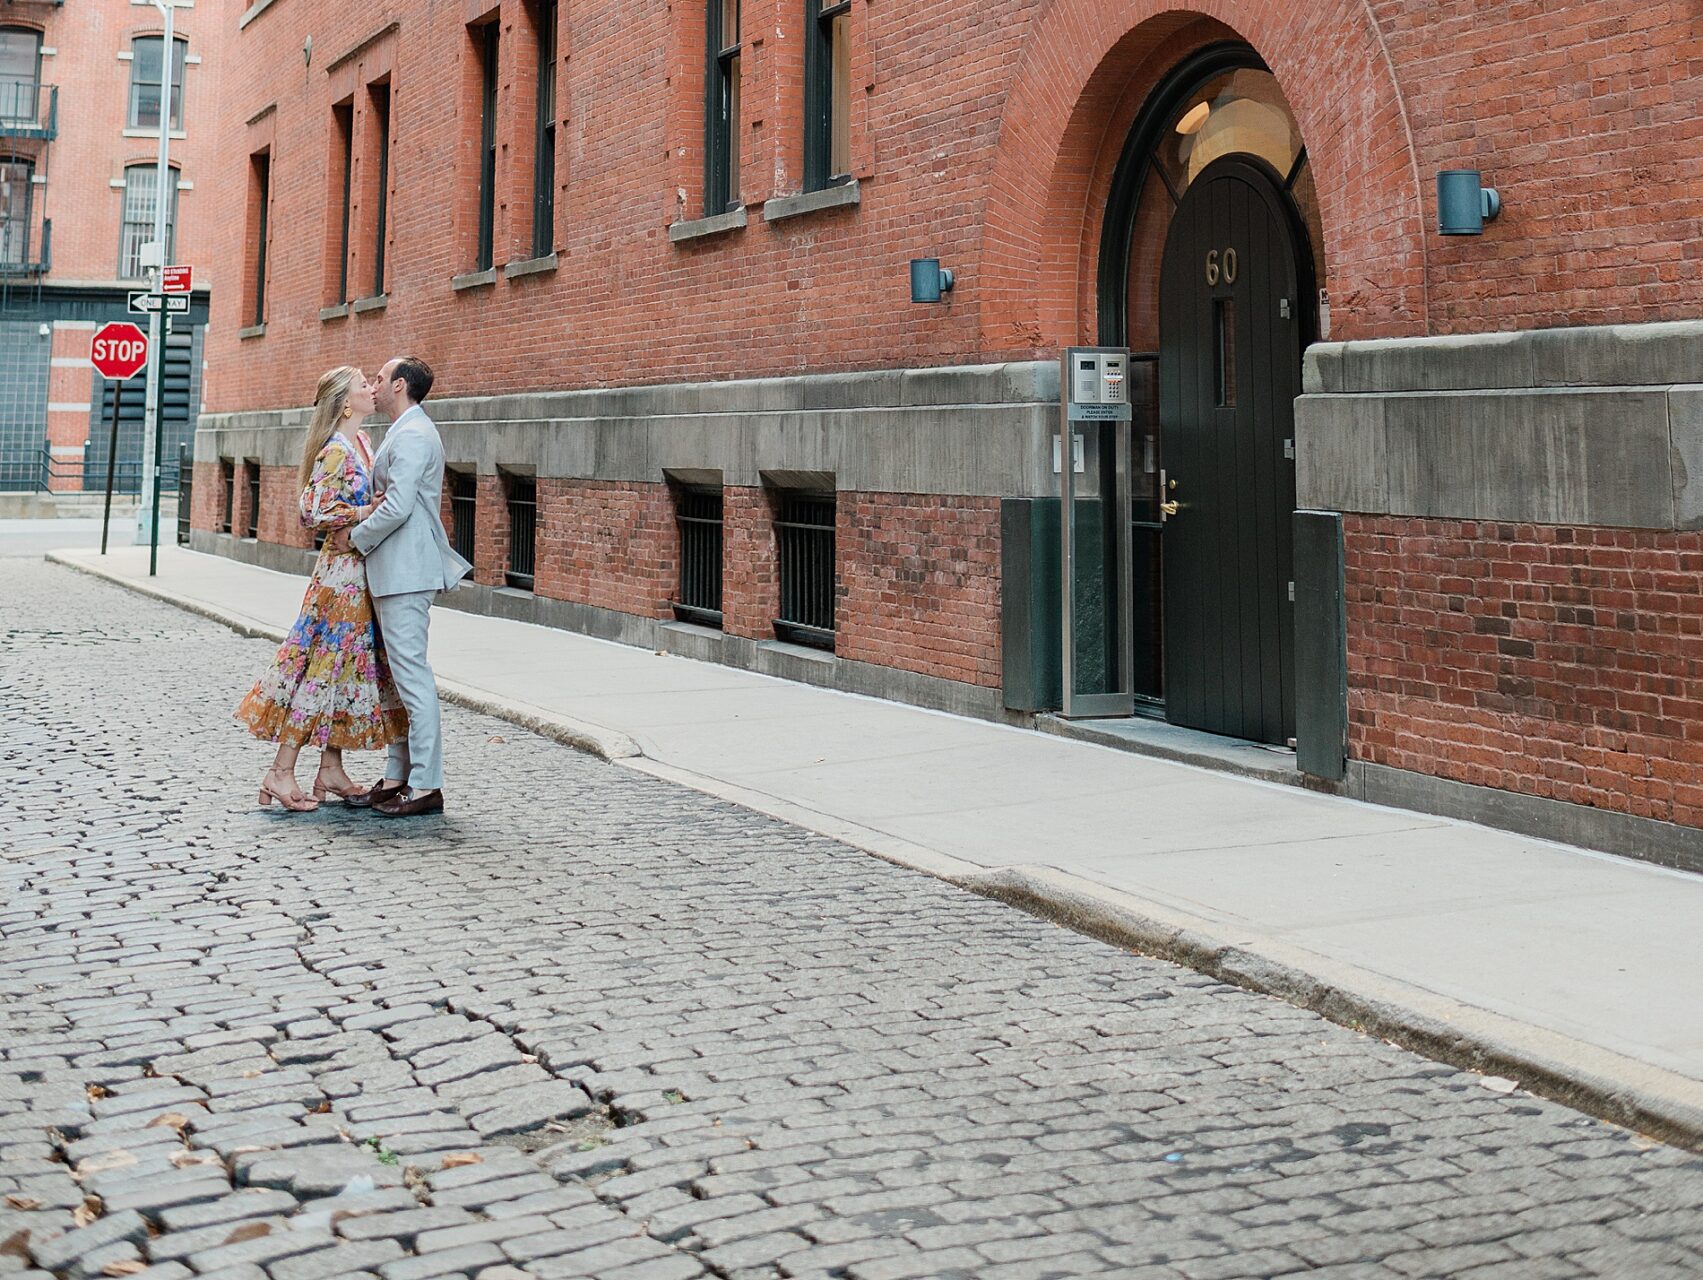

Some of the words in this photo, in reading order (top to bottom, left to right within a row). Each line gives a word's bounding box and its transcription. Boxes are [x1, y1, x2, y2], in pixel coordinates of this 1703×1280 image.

[1206, 248, 1237, 285] 60
[140, 298, 156, 307] ONE
[94, 339, 145, 361] STOP
